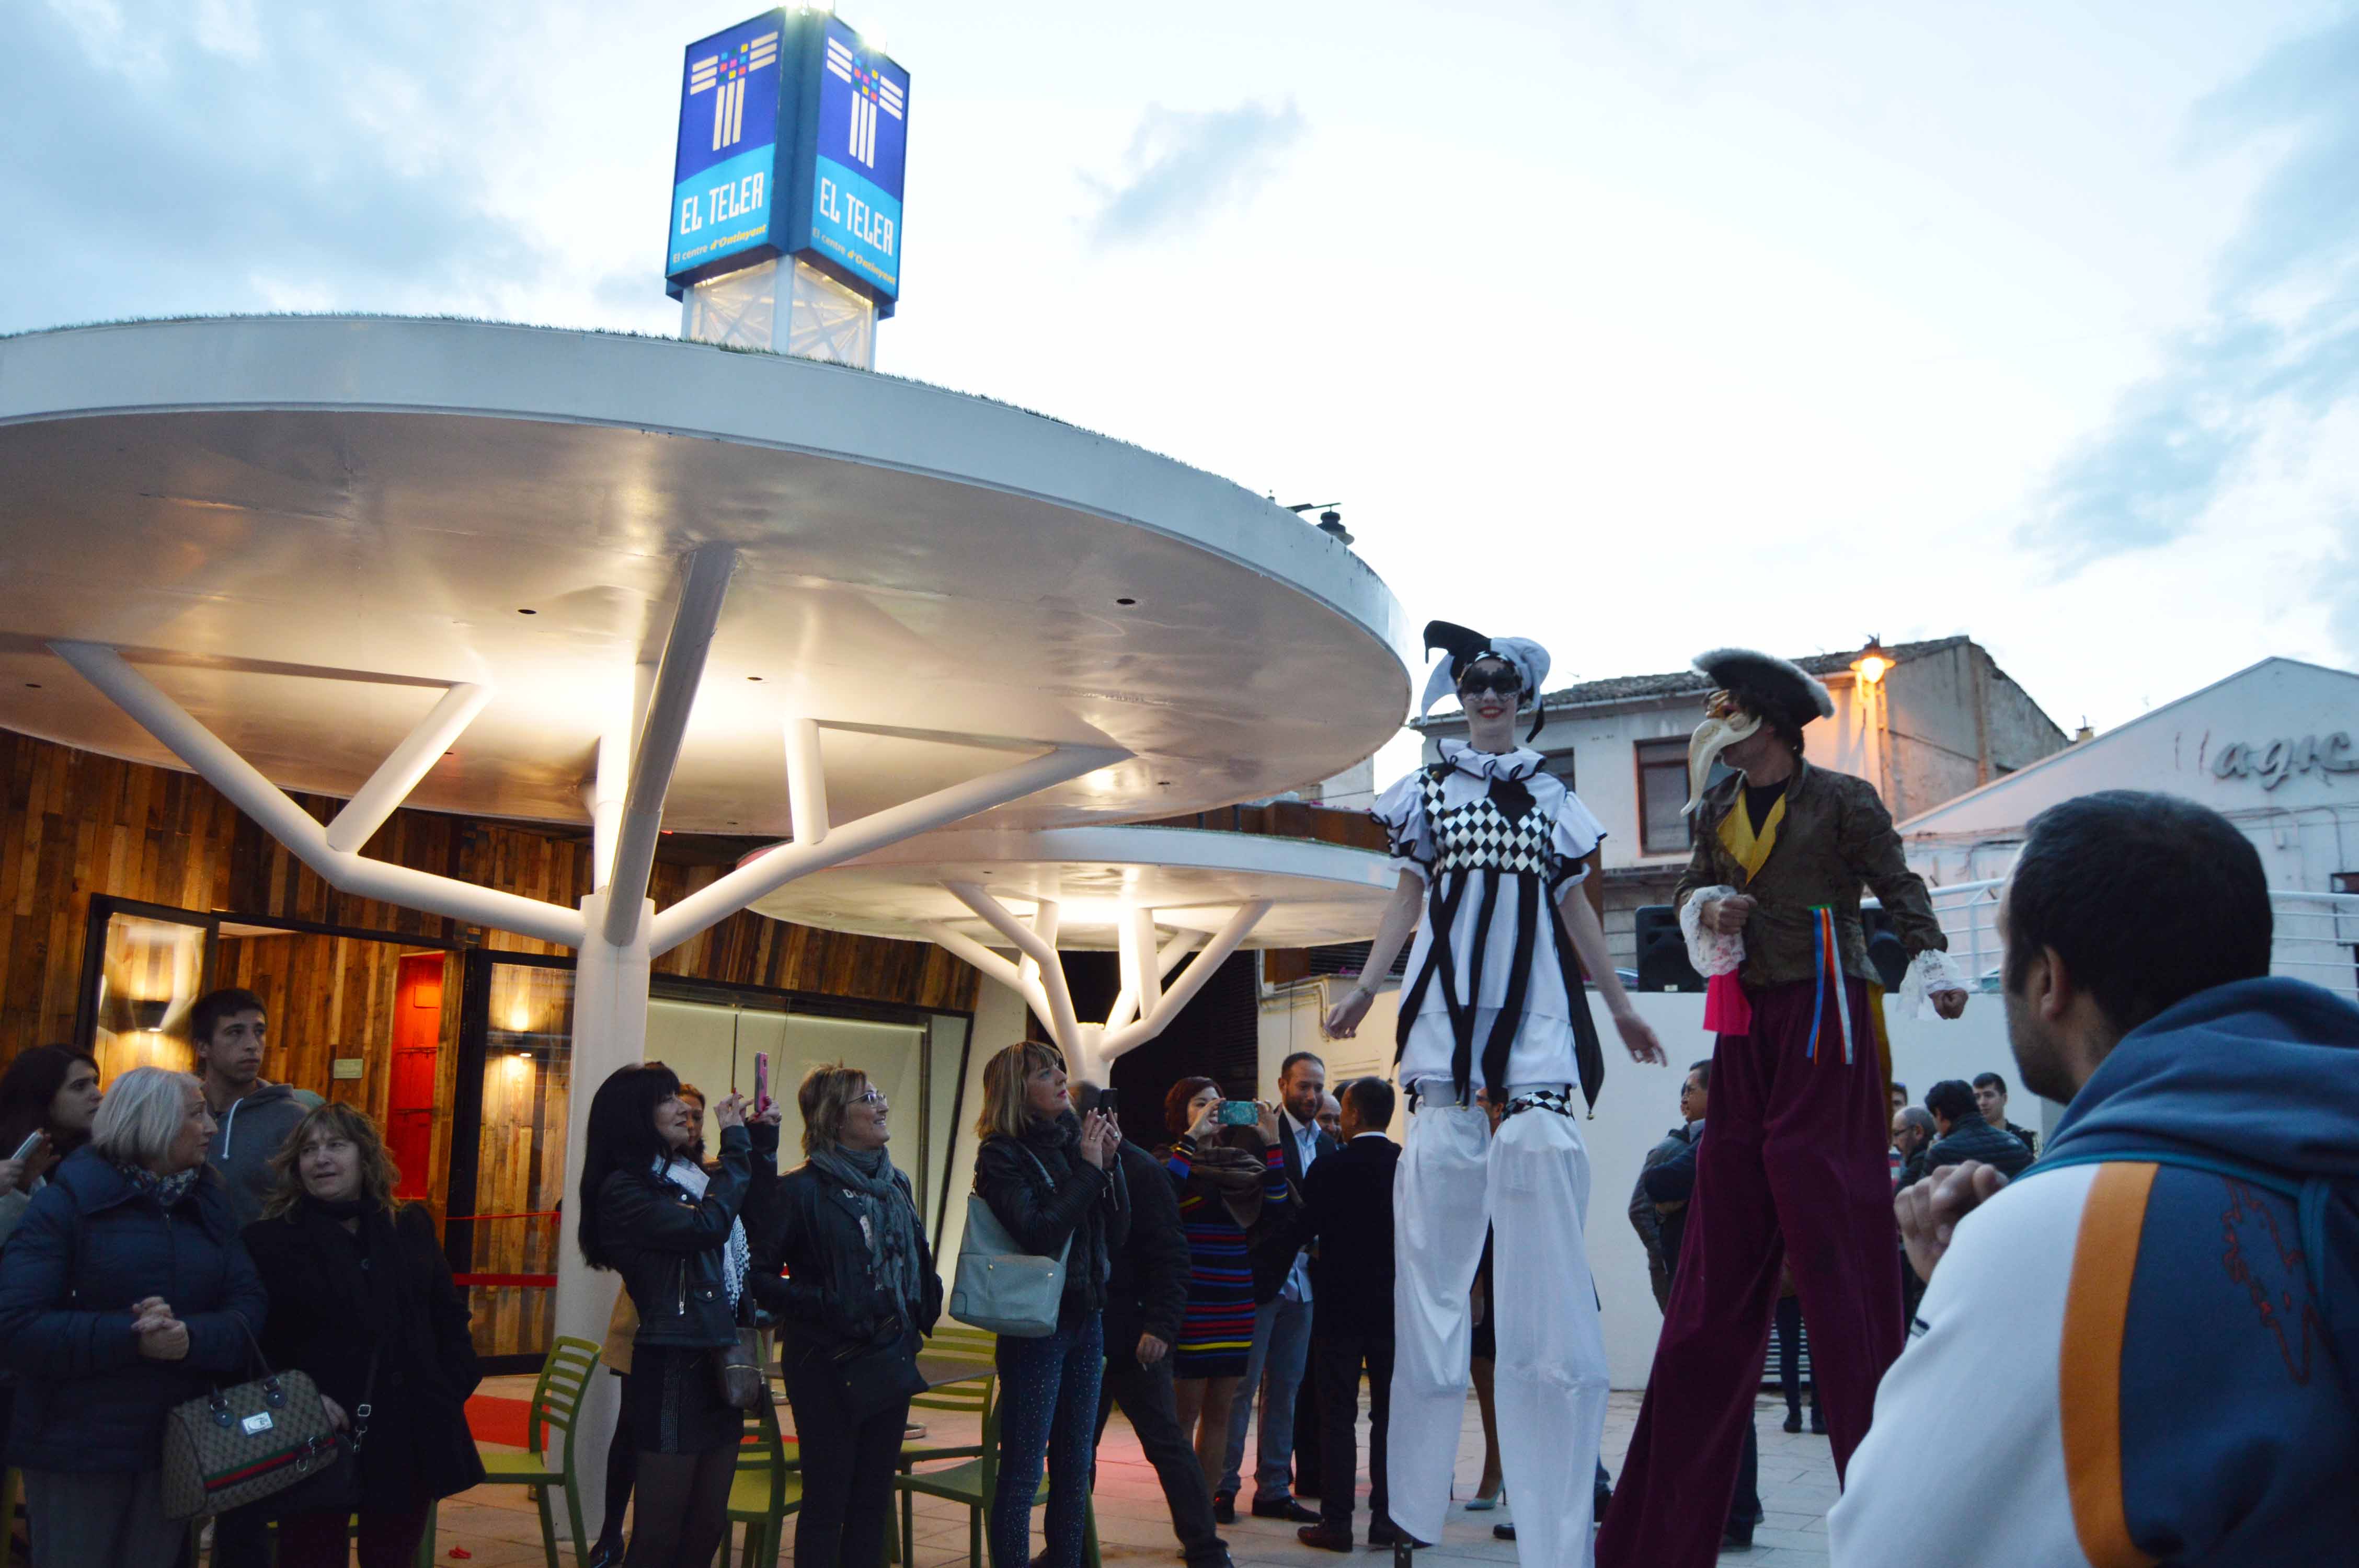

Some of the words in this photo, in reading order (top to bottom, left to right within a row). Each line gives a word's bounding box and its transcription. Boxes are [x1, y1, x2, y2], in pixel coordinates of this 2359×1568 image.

[681, 195, 703, 235] EL
[709, 171, 764, 225] TELER
[820, 177, 840, 224] EL
[846, 192, 894, 257] TELER
[673, 251, 680, 263] El
[682, 245, 707, 260] centre
[710, 224, 767, 251] d'Ontinyent
